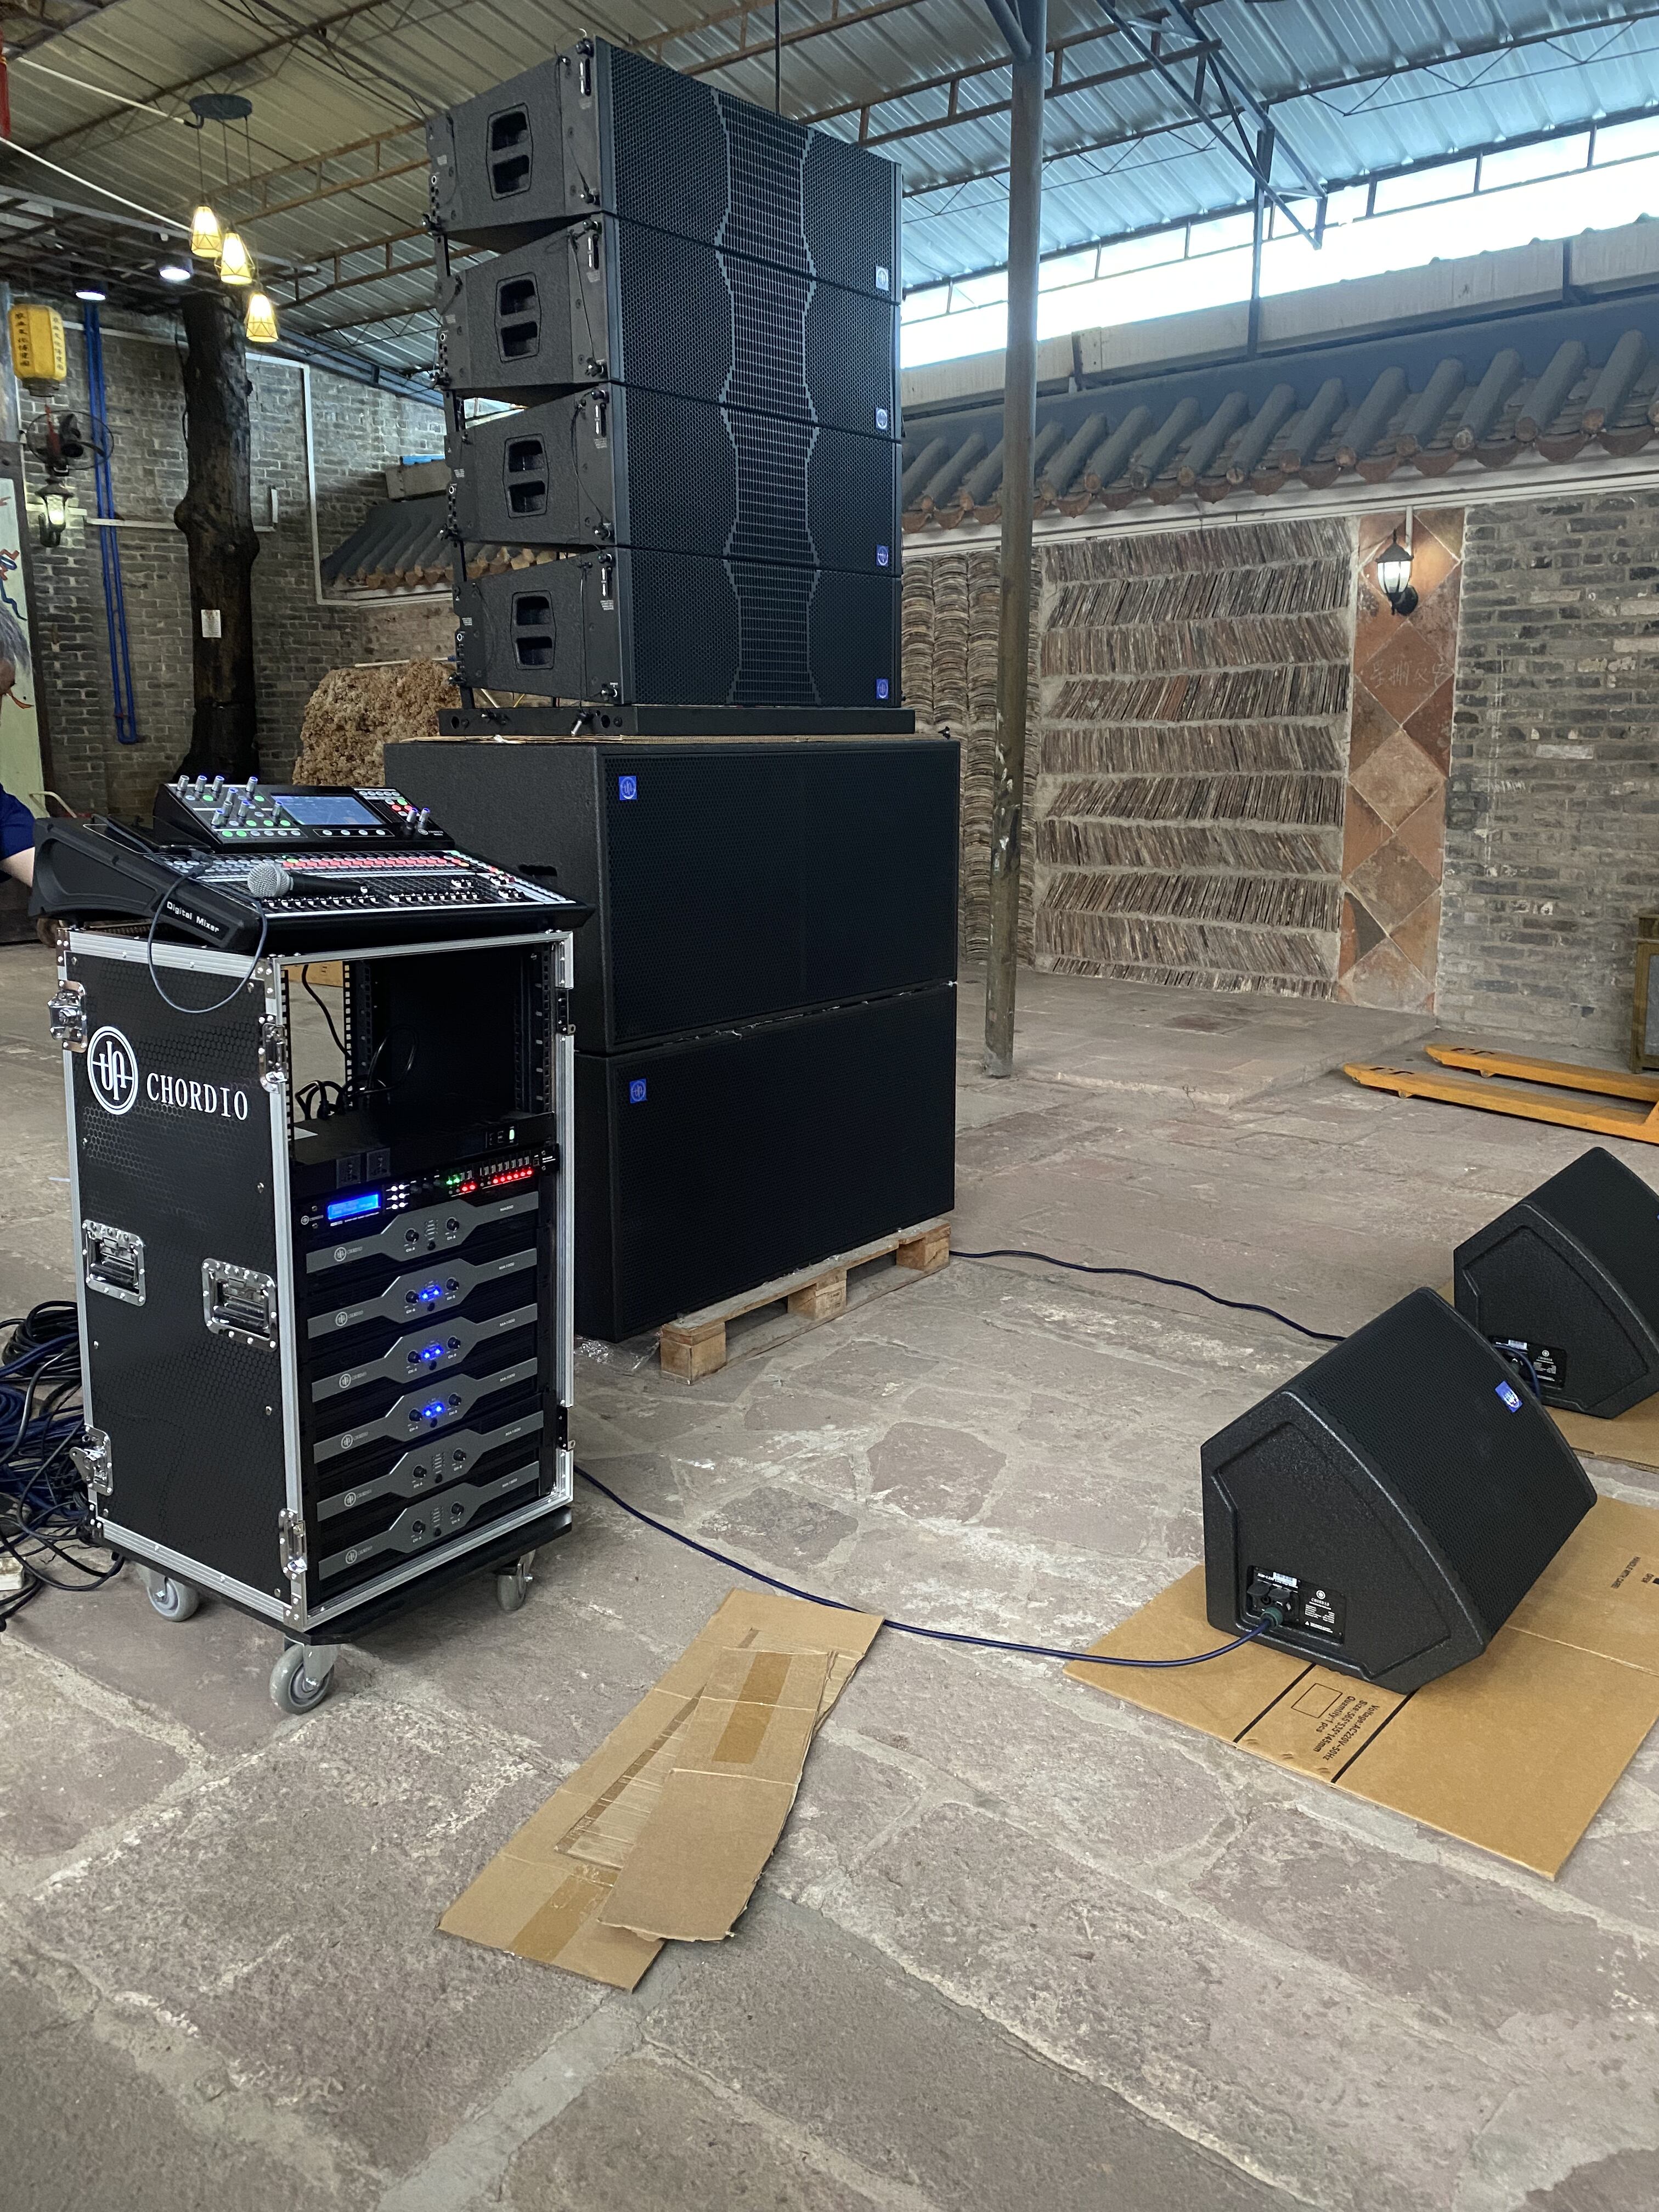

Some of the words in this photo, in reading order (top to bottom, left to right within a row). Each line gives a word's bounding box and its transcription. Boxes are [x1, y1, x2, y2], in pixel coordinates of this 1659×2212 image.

[167, 901, 193, 920] Digital
[196, 916, 219, 932] Mixer
[146, 1073, 248, 1120] CHORDIO
[1316, 1722, 1328, 1733] pcs
